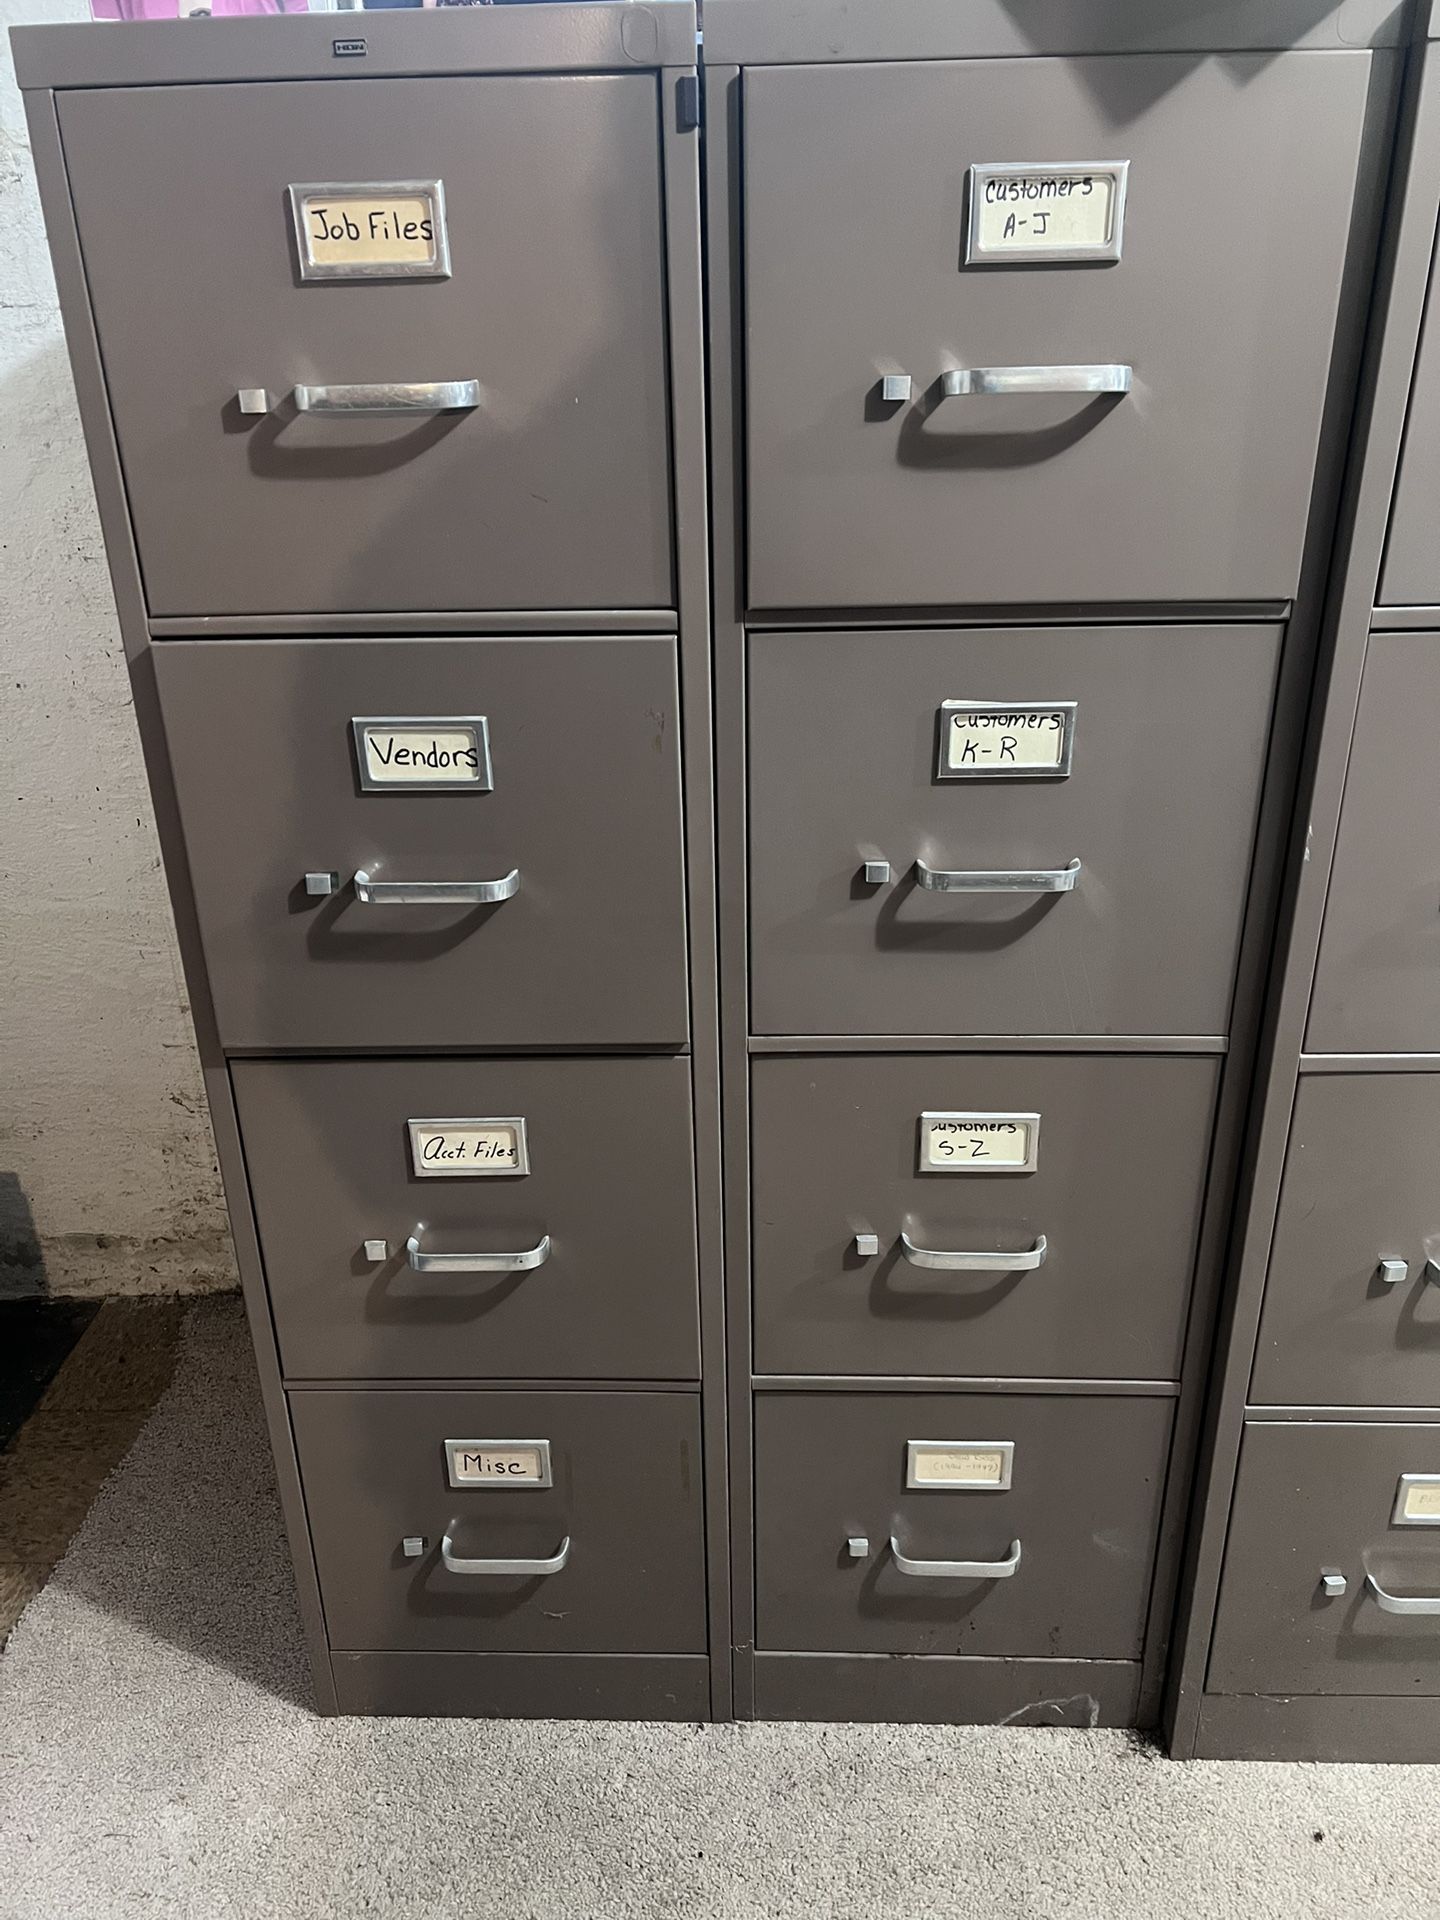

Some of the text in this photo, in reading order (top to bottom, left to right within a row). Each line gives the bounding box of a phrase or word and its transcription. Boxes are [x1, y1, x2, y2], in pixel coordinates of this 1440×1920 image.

[985, 177, 1093, 203] Customers
[311, 208, 434, 241] Job Files
[1003, 211, 1051, 239] A-J
[369, 736, 479, 769] Vendors
[473, 1140, 517, 1159] Files
[463, 1453, 527, 1475] Misc
